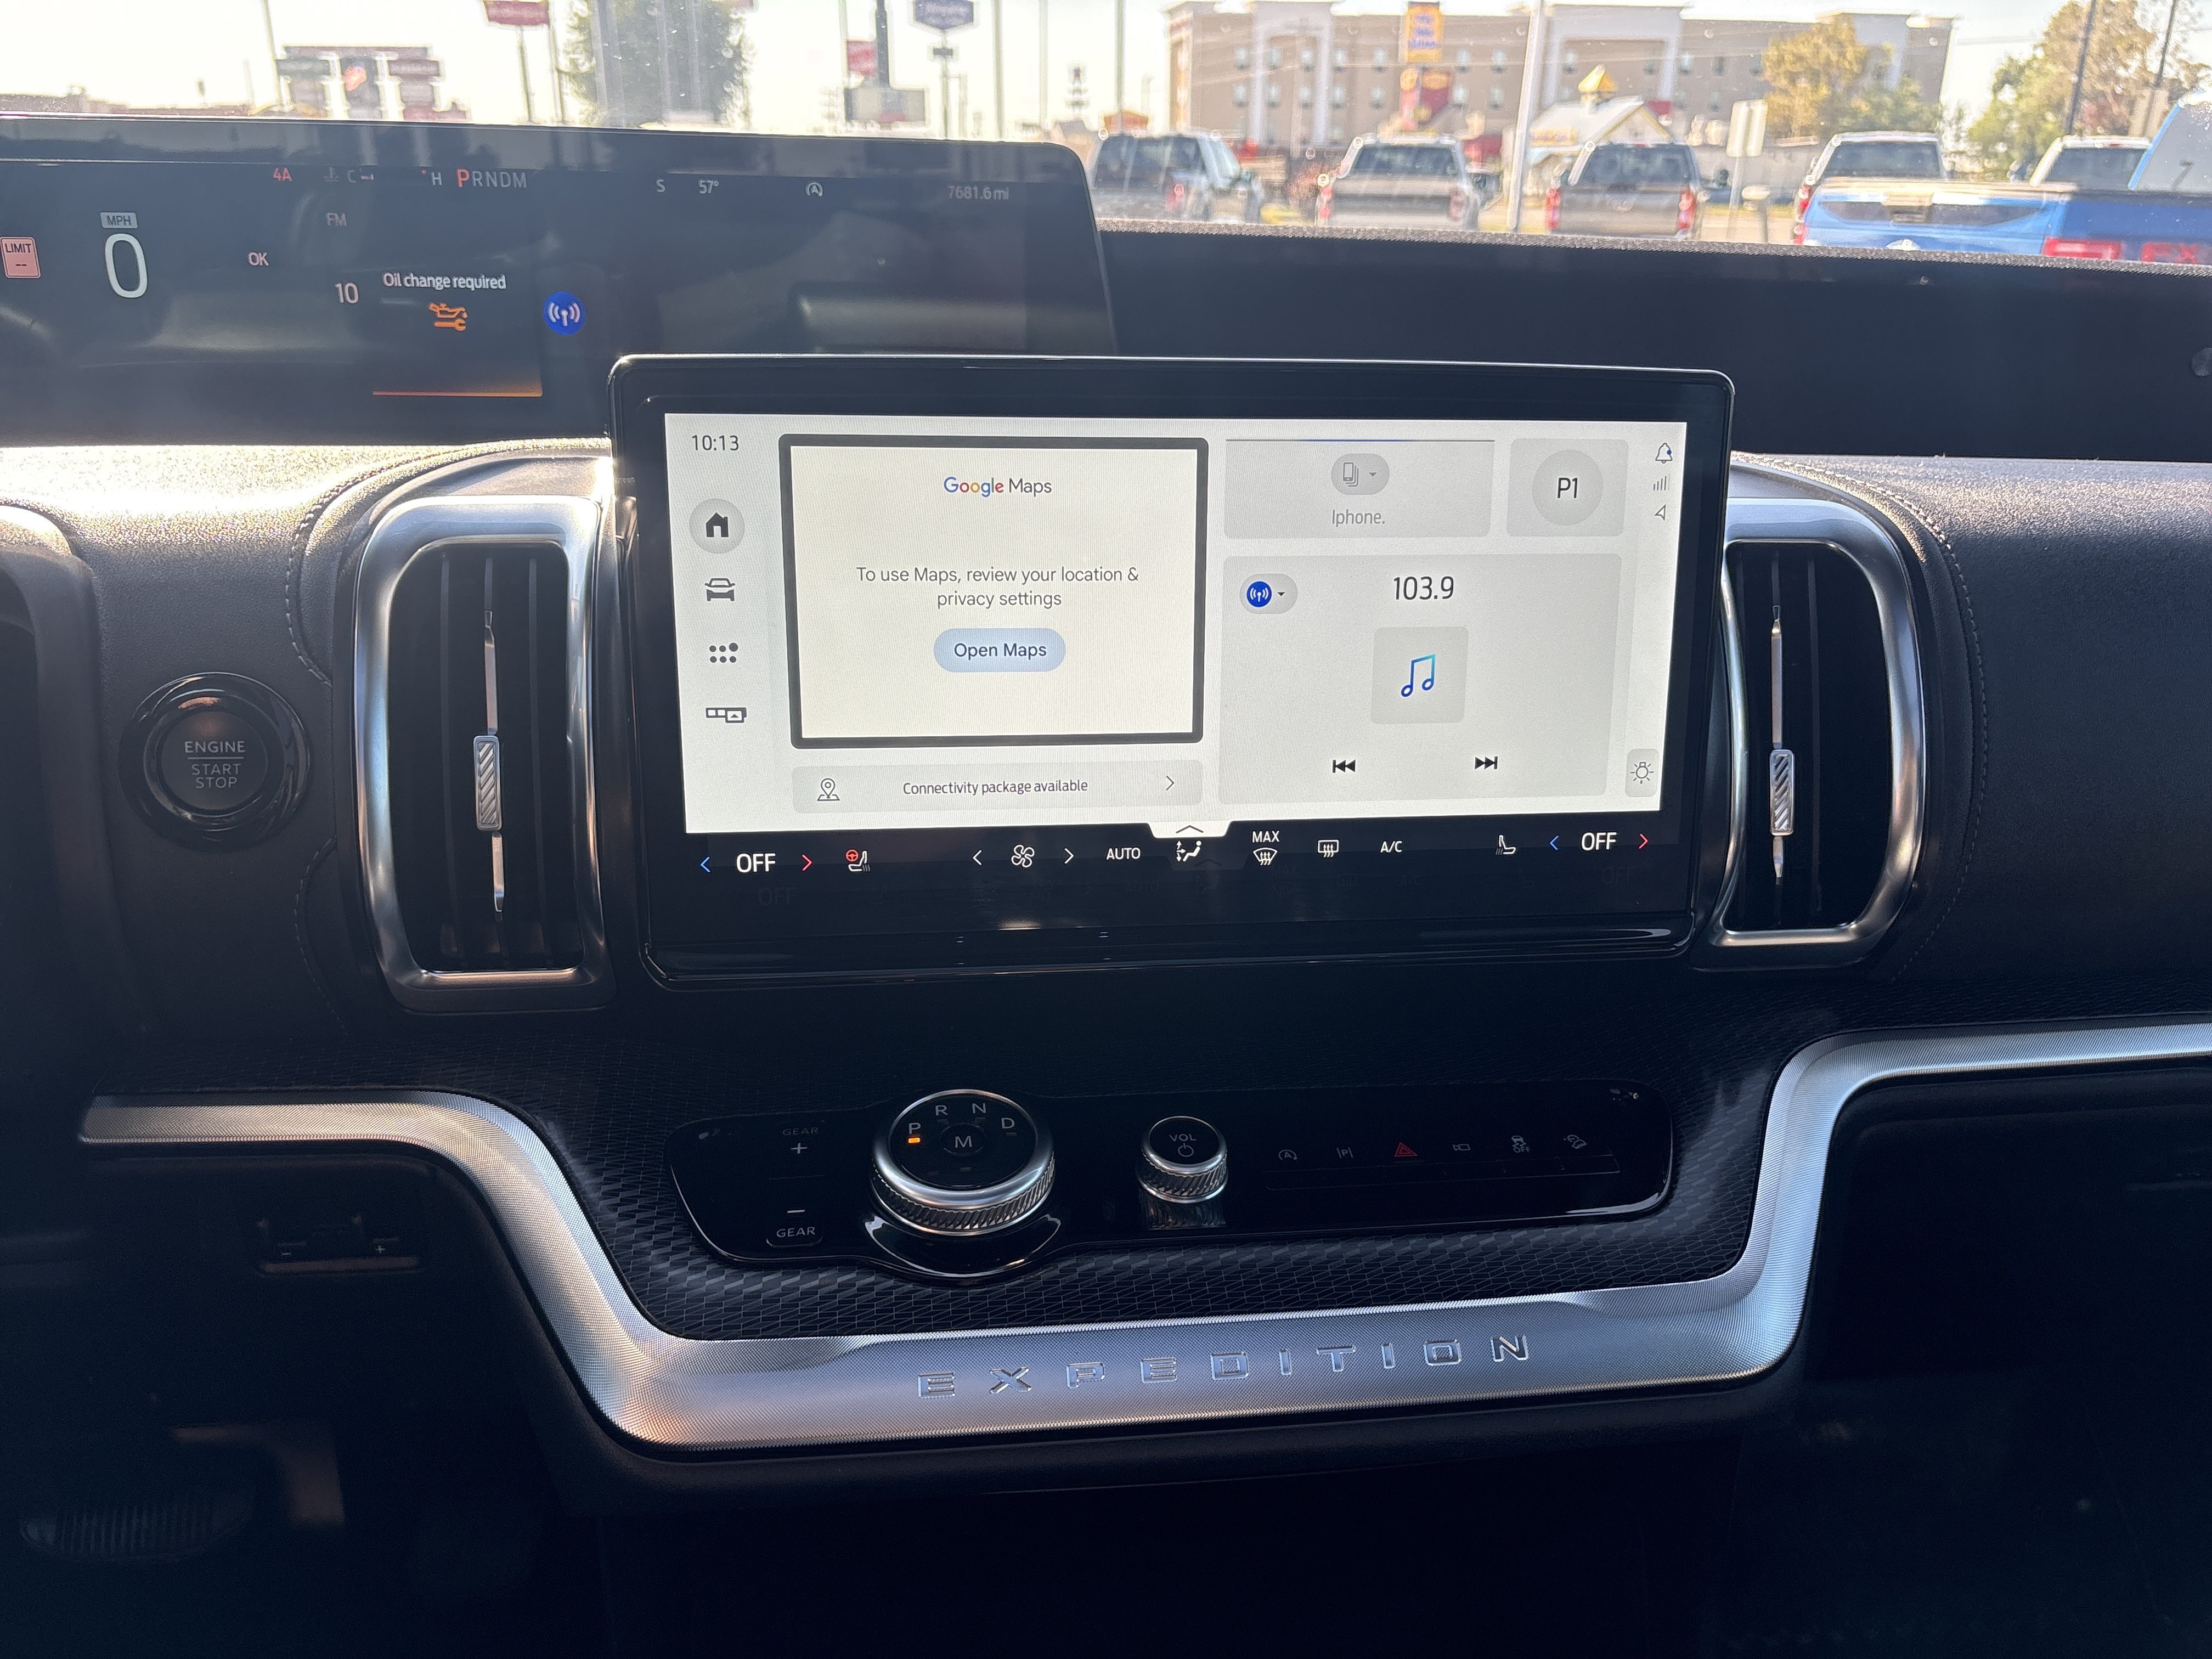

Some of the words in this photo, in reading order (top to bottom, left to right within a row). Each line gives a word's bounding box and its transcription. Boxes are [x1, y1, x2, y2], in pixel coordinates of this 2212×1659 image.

[273, 167, 292, 182] 4A
[655, 179, 665, 193] S
[947, 185, 992, 200] 7681.6
[993, 188, 1009, 200] mi
[106, 215, 132, 226] MPH
[326, 212, 347, 227] FM
[4, 242, 32, 254] LIMIT
[105, 233, 148, 298] 0
[247, 251, 269, 267] OK
[382, 272, 402, 287] Oil
[404, 273, 450, 290] change
[452, 274, 506, 291] required
[335, 281, 359, 303] 10
[691, 435, 740, 452] 10:13
[943, 476, 1005, 497] Google
[1008, 478, 1052, 496] Maps
[1556, 477, 1579, 499] P1
[1331, 509, 1386, 528] Iphone.
[856, 567, 877, 582] To
[880, 569, 909, 582] use
[914, 567, 961, 585] Maps,
[966, 567, 1017, 582] review
[1021, 569, 1057, 586] your
[1060, 566, 1123, 582] location
[1127, 567, 1139, 582] &
[1392, 576, 1455, 602] 103.9
[936, 590, 995, 610] privacy
[999, 590, 1062, 610] settings
[953, 643, 998, 661] Open
[1003, 643, 1047, 661] Maps
[184, 741, 246, 754] ENGINE
[192, 763, 242, 776] START
[195, 776, 238, 789] STOP
[902, 781, 979, 796] Connectivity
[981, 780, 1032, 795] package
[1034, 779, 1088, 793] available
[1251, 830, 1280, 844] MAX
[1581, 832, 1617, 851] OFF
[1105, 847, 1141, 861] AUTO
[1380, 840, 1403, 854] A/C
[736, 853, 776, 874] OFF
[934, 1104, 949, 1117] R
[972, 1102, 987, 1115] N
[908, 1122, 922, 1135] P
[1001, 1117, 1016, 1130] D
[782, 1126, 820, 1137] GEAR
[1169, 1133, 1198, 1143] VOL
[954, 1135, 974, 1149] M
[776, 1226, 816, 1239] GEAR
[917, 1333, 1530, 1400] EXPEDITION
